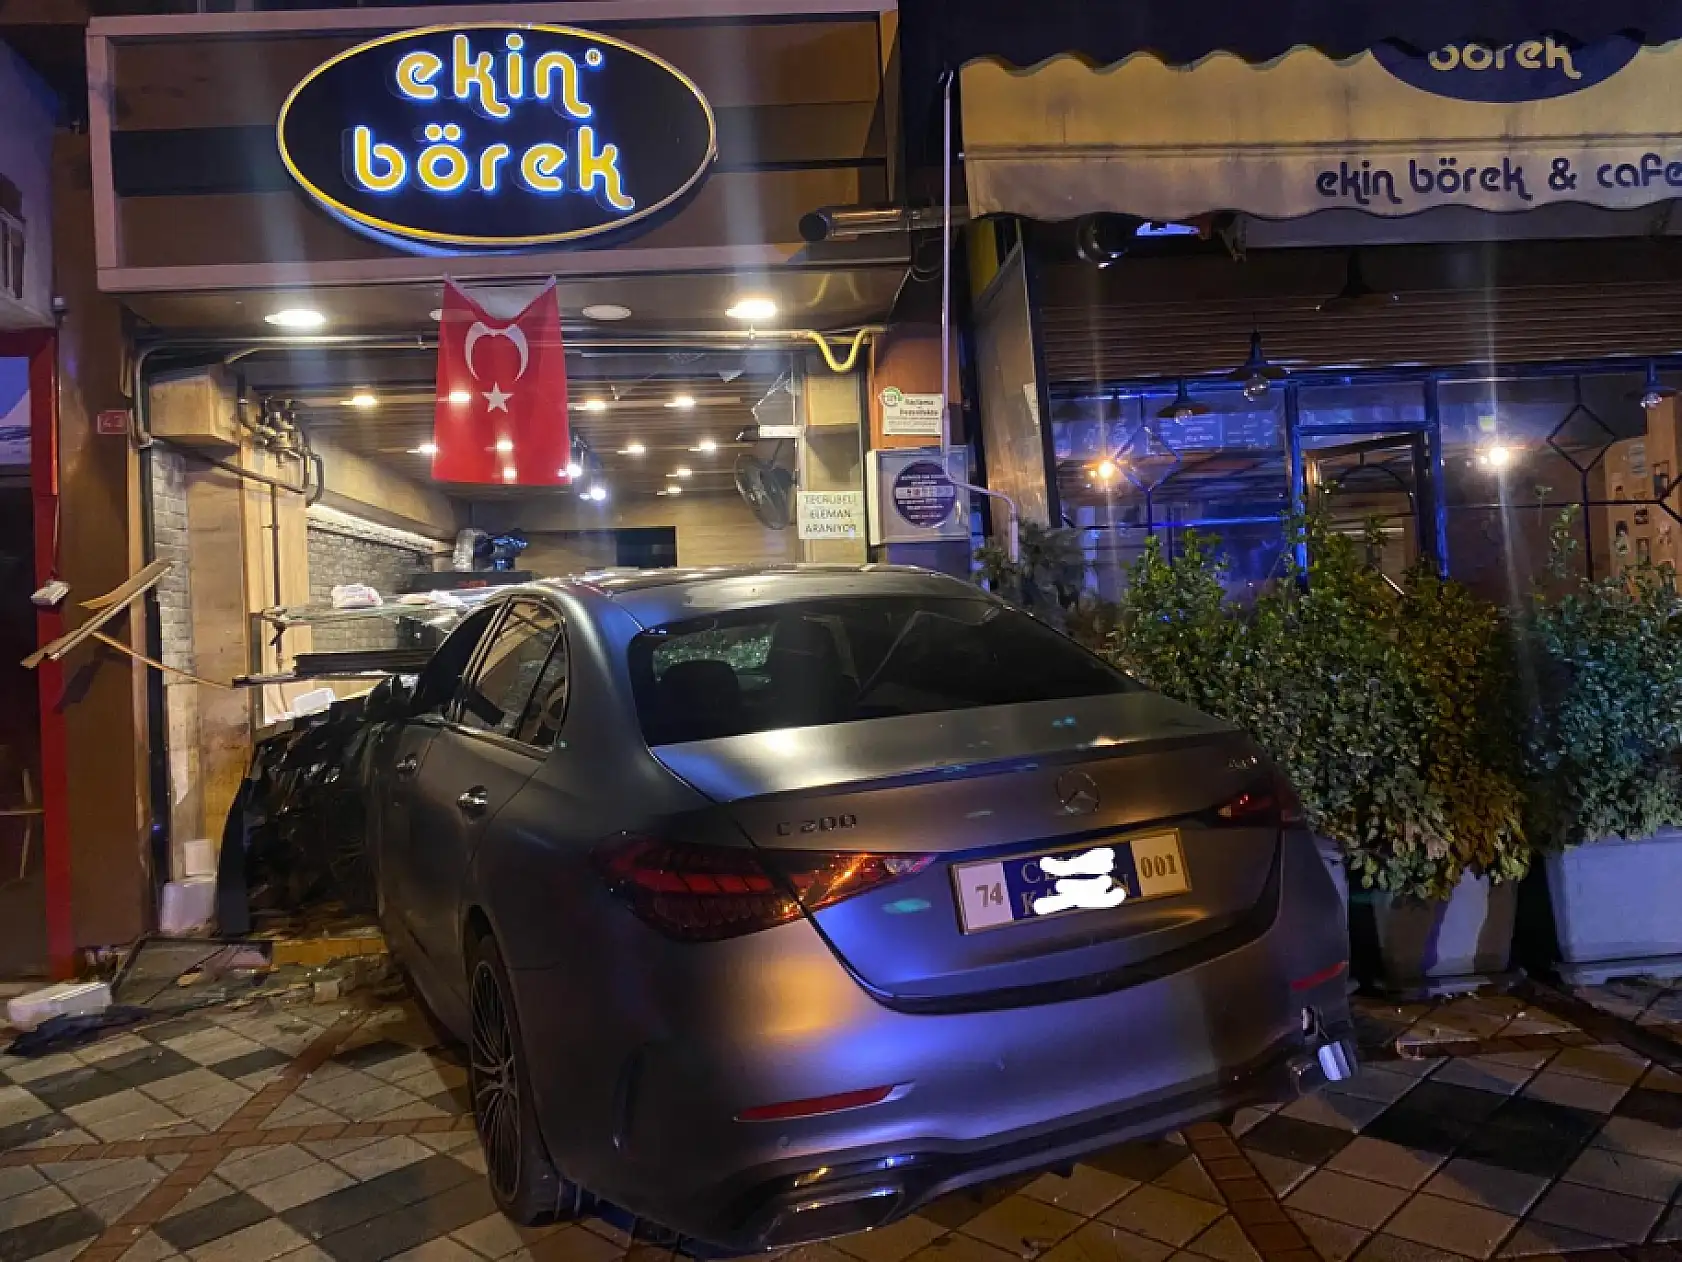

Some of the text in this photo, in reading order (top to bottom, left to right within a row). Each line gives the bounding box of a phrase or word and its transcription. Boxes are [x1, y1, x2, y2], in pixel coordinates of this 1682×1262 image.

[395, 33, 592, 119] ekin
[353, 123, 636, 211] börek
[1316, 153, 1682, 205] ekin börek & cafe
[776, 814, 857, 836] C 200
[1139, 853, 1177, 878] 001
[975, 882, 1004, 908] 74
